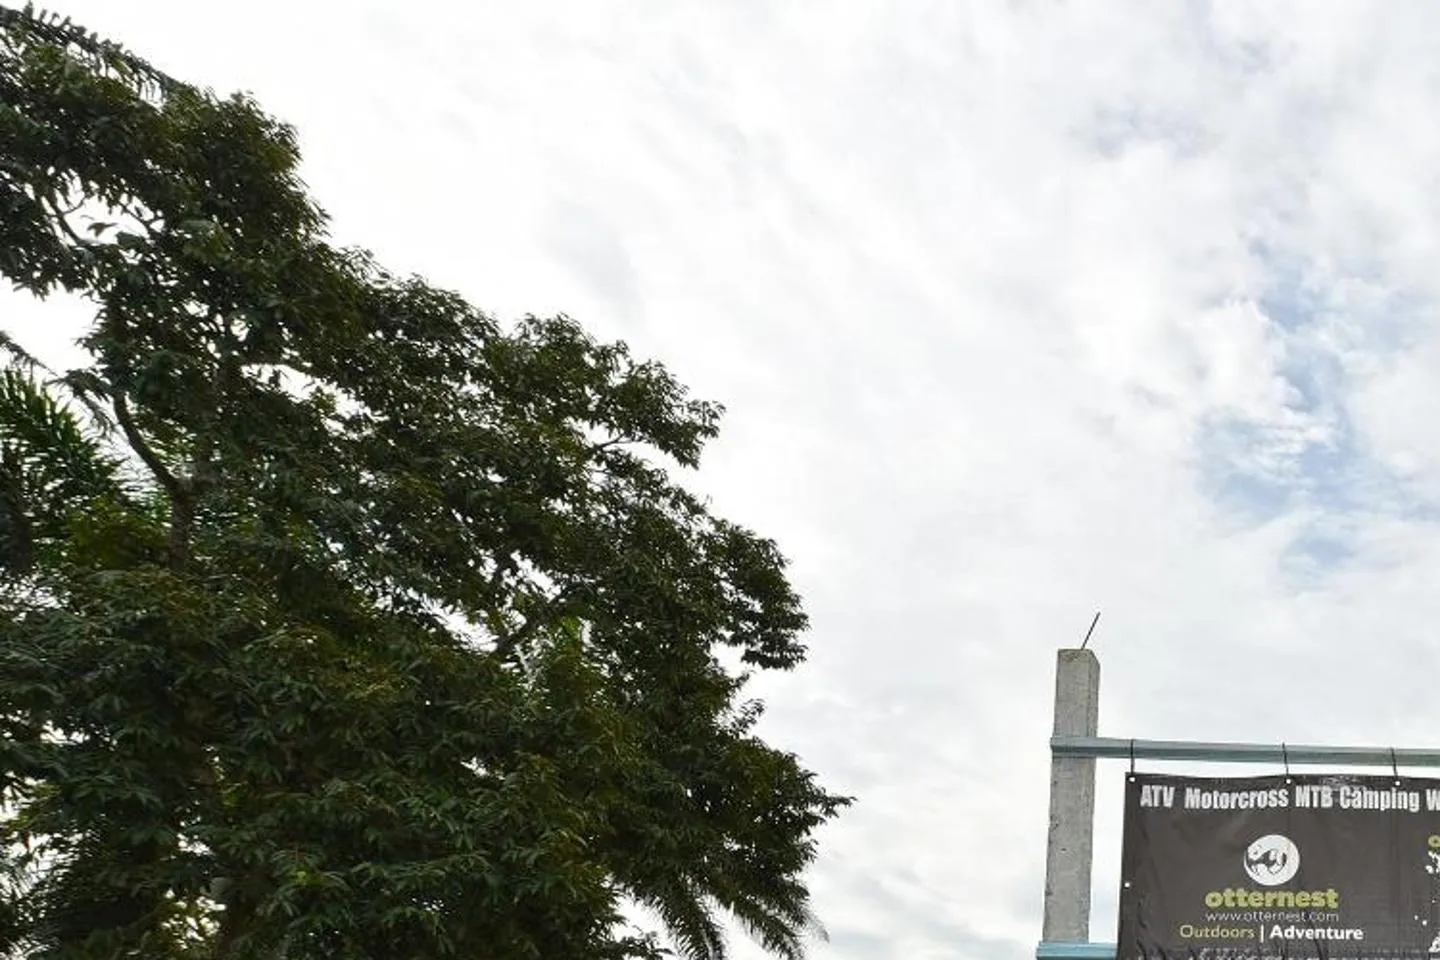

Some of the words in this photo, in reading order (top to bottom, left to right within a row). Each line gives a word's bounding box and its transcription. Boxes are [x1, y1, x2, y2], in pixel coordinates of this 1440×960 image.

[1140, 785, 1175, 808] ATV
[1185, 788, 1288, 809] Motorcross
[1296, 788, 1333, 808] MTB
[1340, 788, 1420, 812] Camping
[1205, 888, 1339, 908] otternest
[1206, 911, 1339, 922] www.otternest.com
[1180, 924, 1255, 939] Outdoors
[1270, 924, 1364, 940] Adventure
